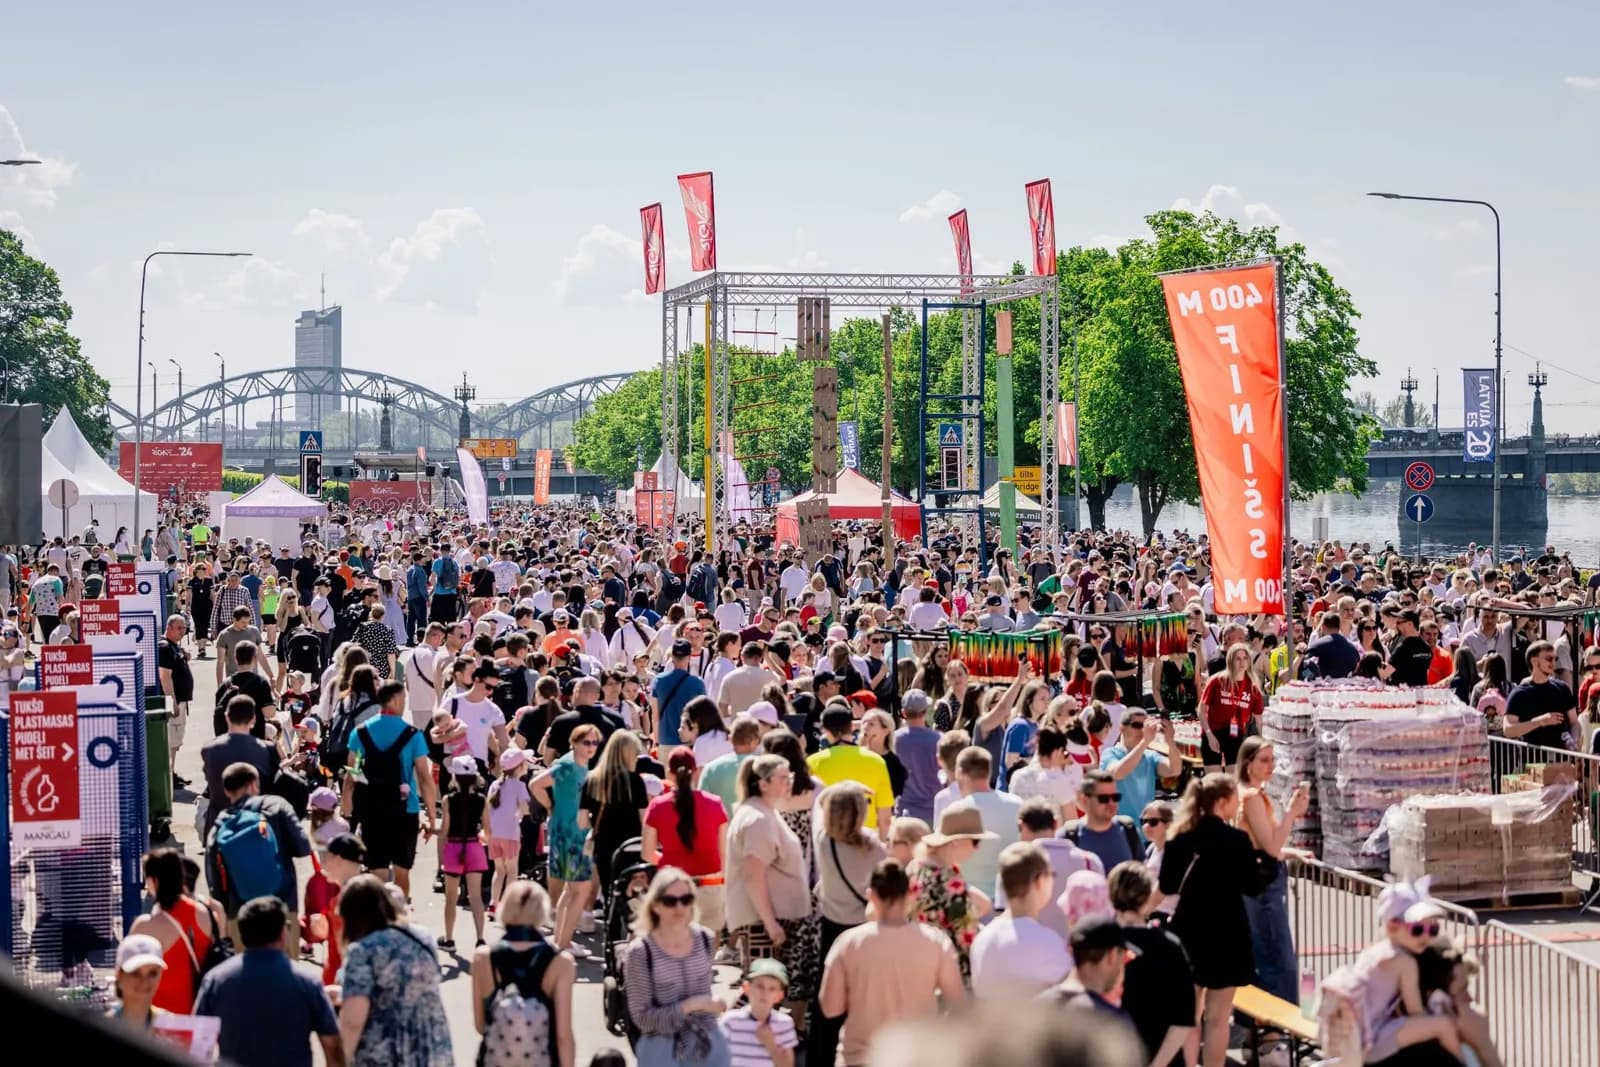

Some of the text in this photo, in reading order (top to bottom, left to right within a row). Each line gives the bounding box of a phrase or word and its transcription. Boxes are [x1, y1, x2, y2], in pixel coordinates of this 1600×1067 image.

[1479, 375, 1490, 428] LATVIJA
[1466, 411, 1478, 428] ES
[44, 649, 67, 662] TUKŠO
[44, 662, 91, 674] PLASTMASAS
[44, 674, 69, 686] PUDELI
[14, 696, 44, 714] TUKŠO
[14, 714, 74, 729] PLASTMASAS
[14, 730, 46, 745] PUDELI
[15, 743, 57, 760] MET ŠEIT
